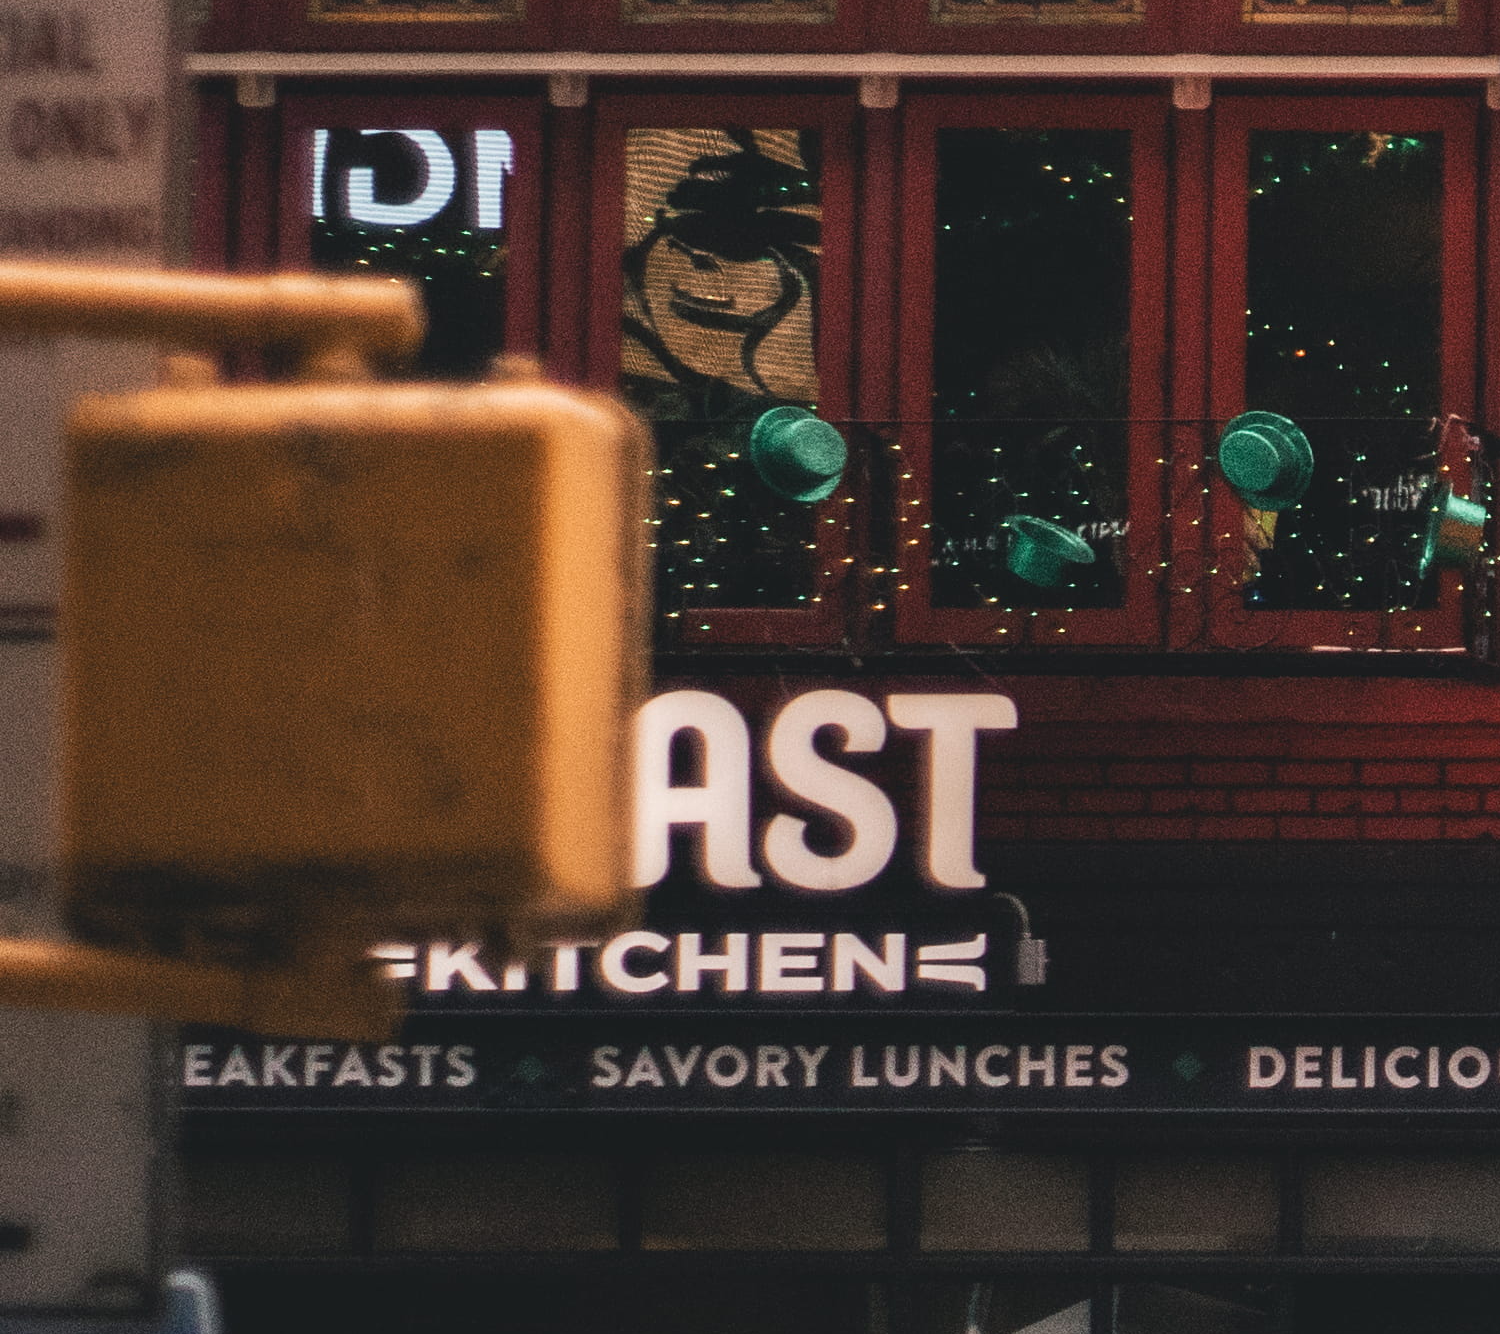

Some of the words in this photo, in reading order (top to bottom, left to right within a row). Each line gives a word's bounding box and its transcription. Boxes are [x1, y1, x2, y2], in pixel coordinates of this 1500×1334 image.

[634, 688, 1017, 890] AST
[183, 1044, 477, 1088] EAKFASTS
[592, 1044, 831, 1088] SAVORY
[851, 1044, 1130, 1089] LUNCHES
